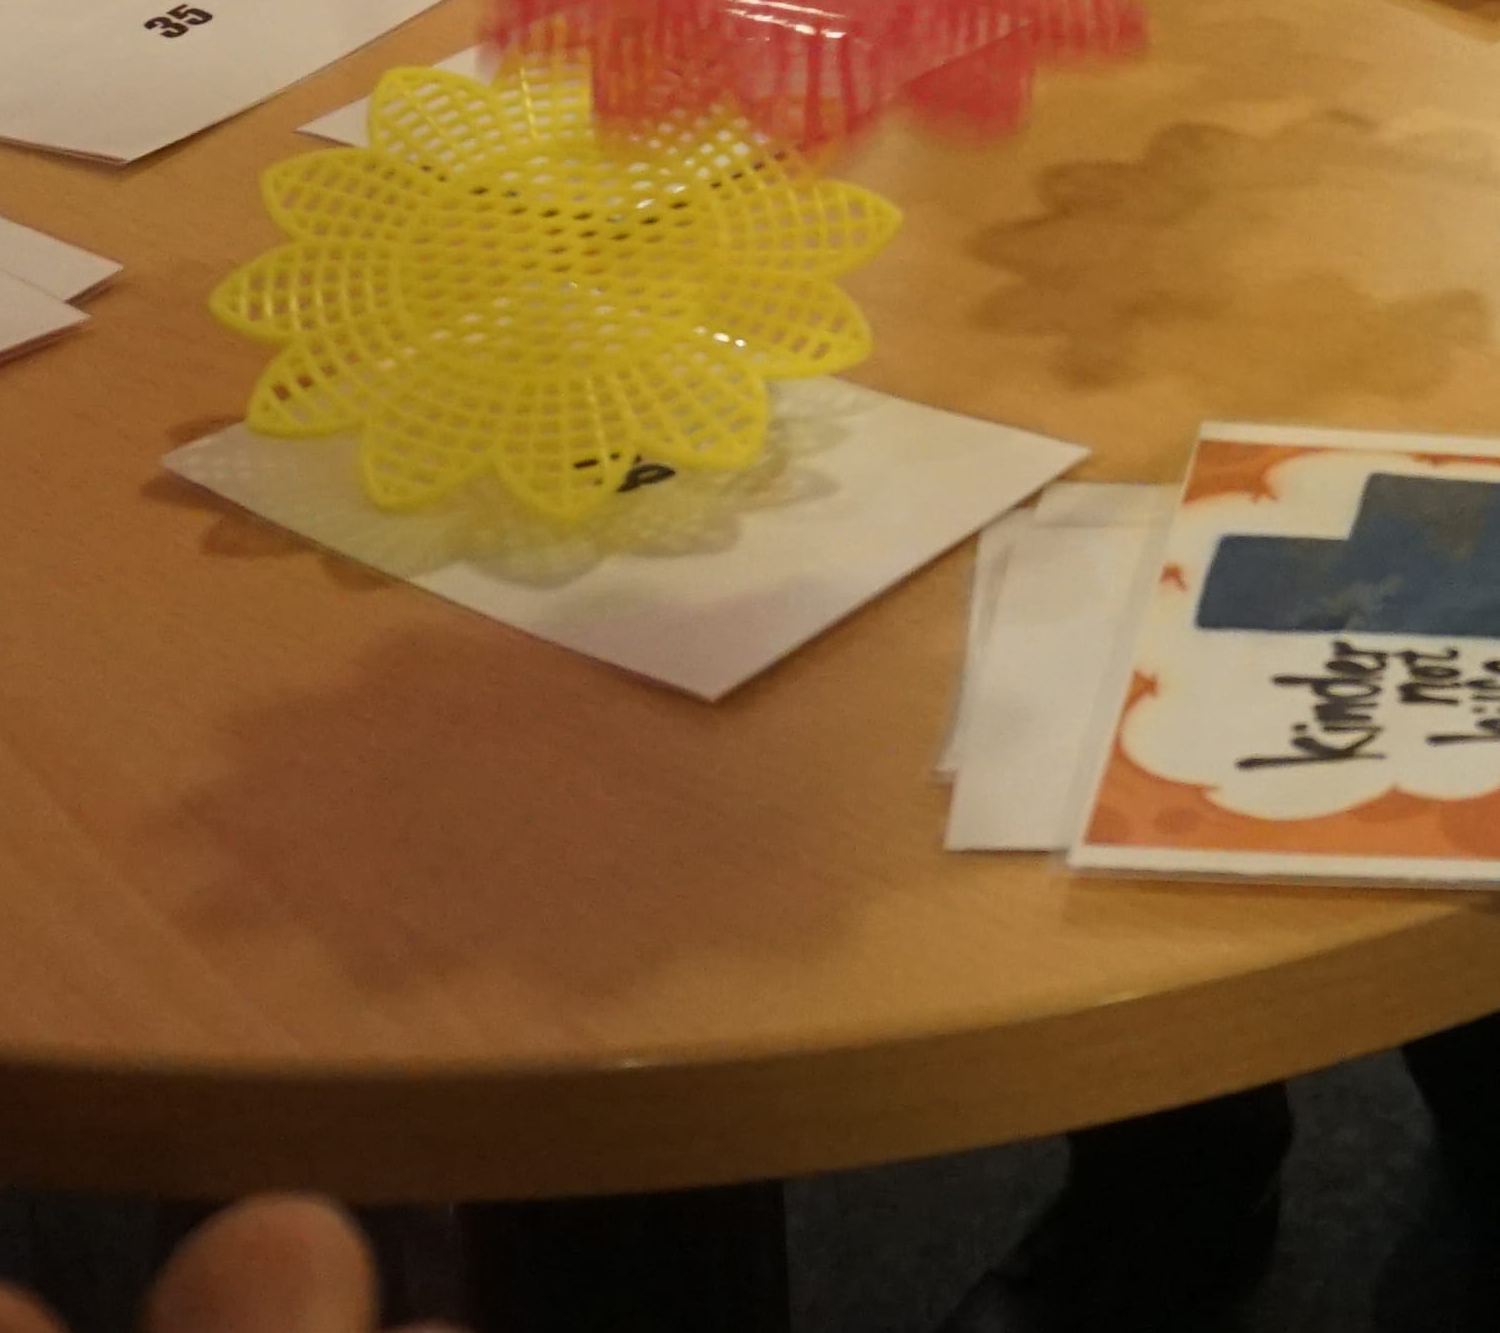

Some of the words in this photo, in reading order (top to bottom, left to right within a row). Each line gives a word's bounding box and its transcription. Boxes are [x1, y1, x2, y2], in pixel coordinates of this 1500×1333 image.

[143, 4, 214, 39] 35
[1236, 640, 1391, 770] kinder
[1396, 645, 1460, 707] not
